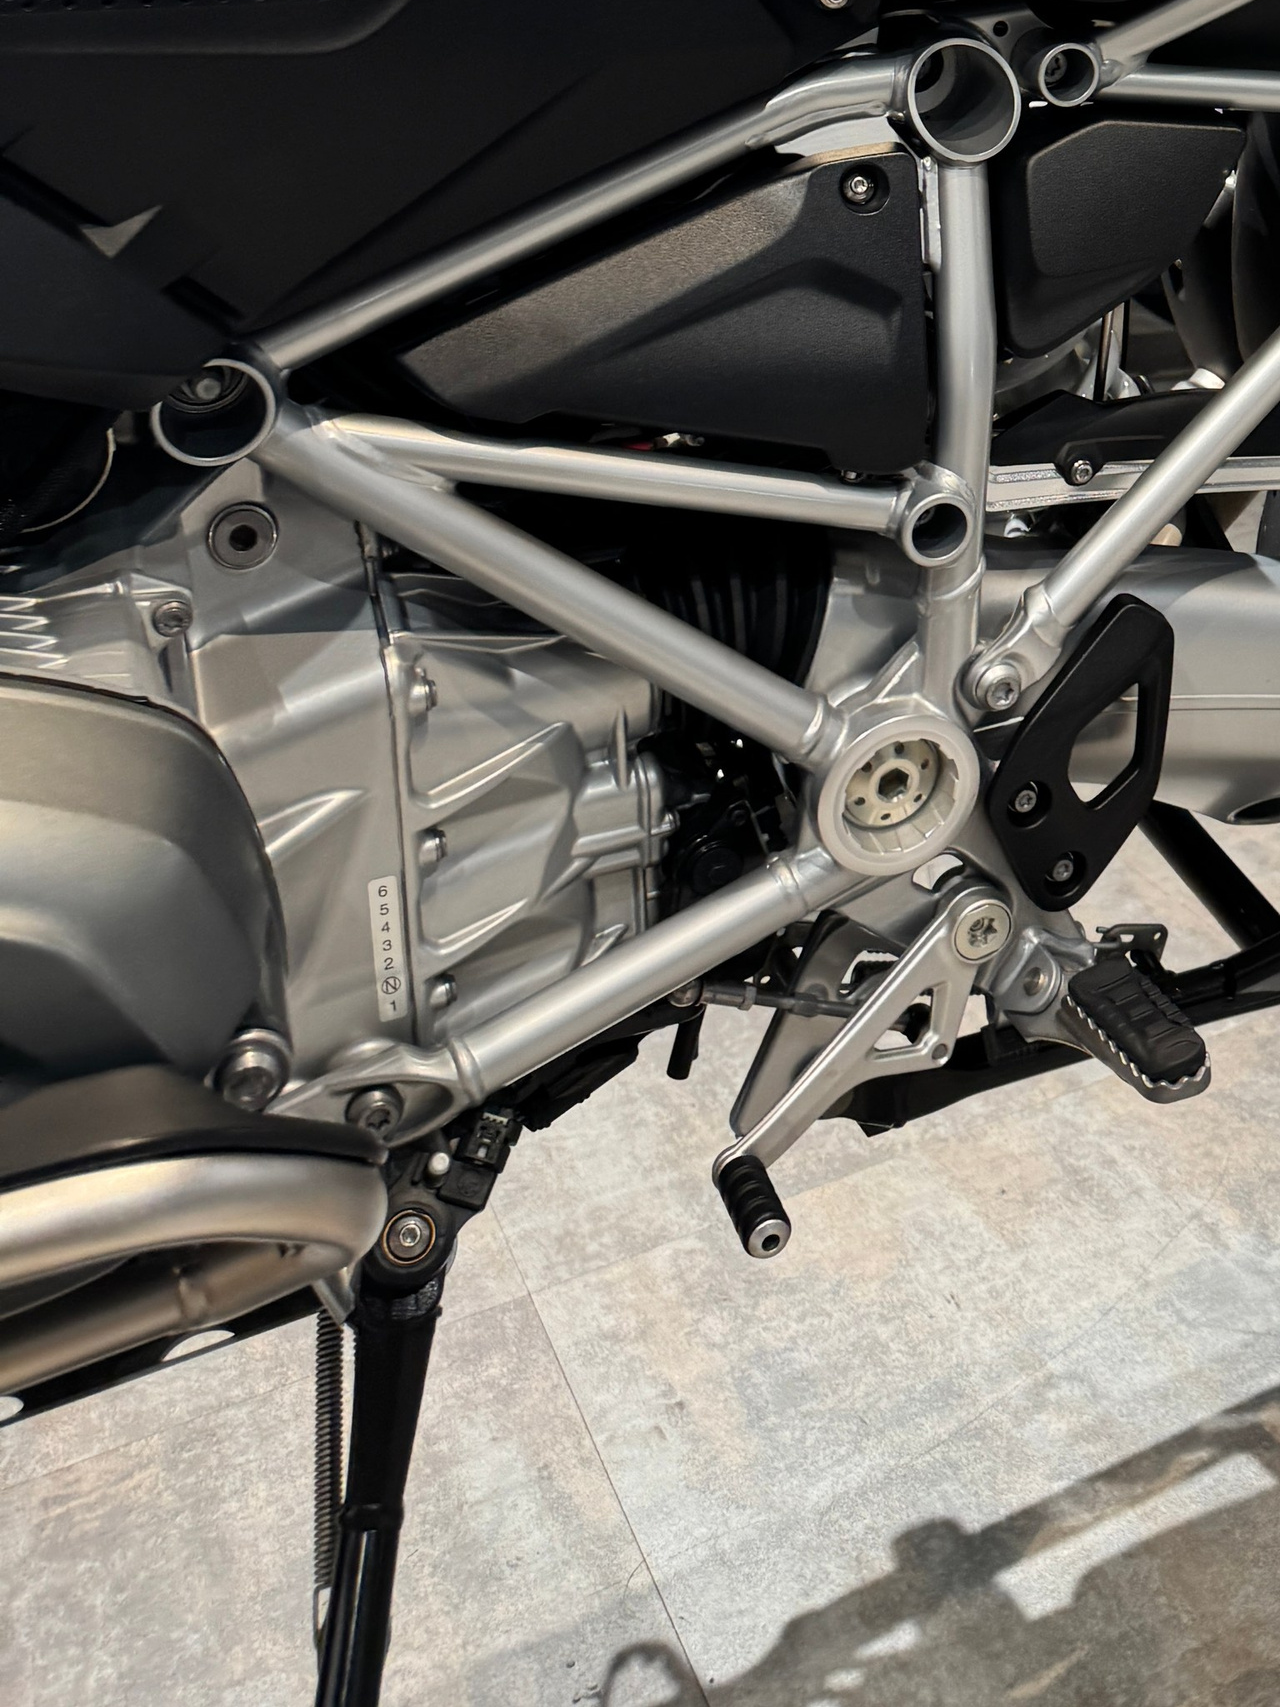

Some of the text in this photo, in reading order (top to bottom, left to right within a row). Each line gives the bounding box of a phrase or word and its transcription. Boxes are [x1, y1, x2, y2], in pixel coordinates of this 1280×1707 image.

[378, 885, 388, 898] 6
[379, 903, 390, 916] 5
[381, 921, 391, 933] 4
[382, 939, 392, 952] 3
[383, 957, 395, 971] 2
[389, 1000, 397, 1012] 1
